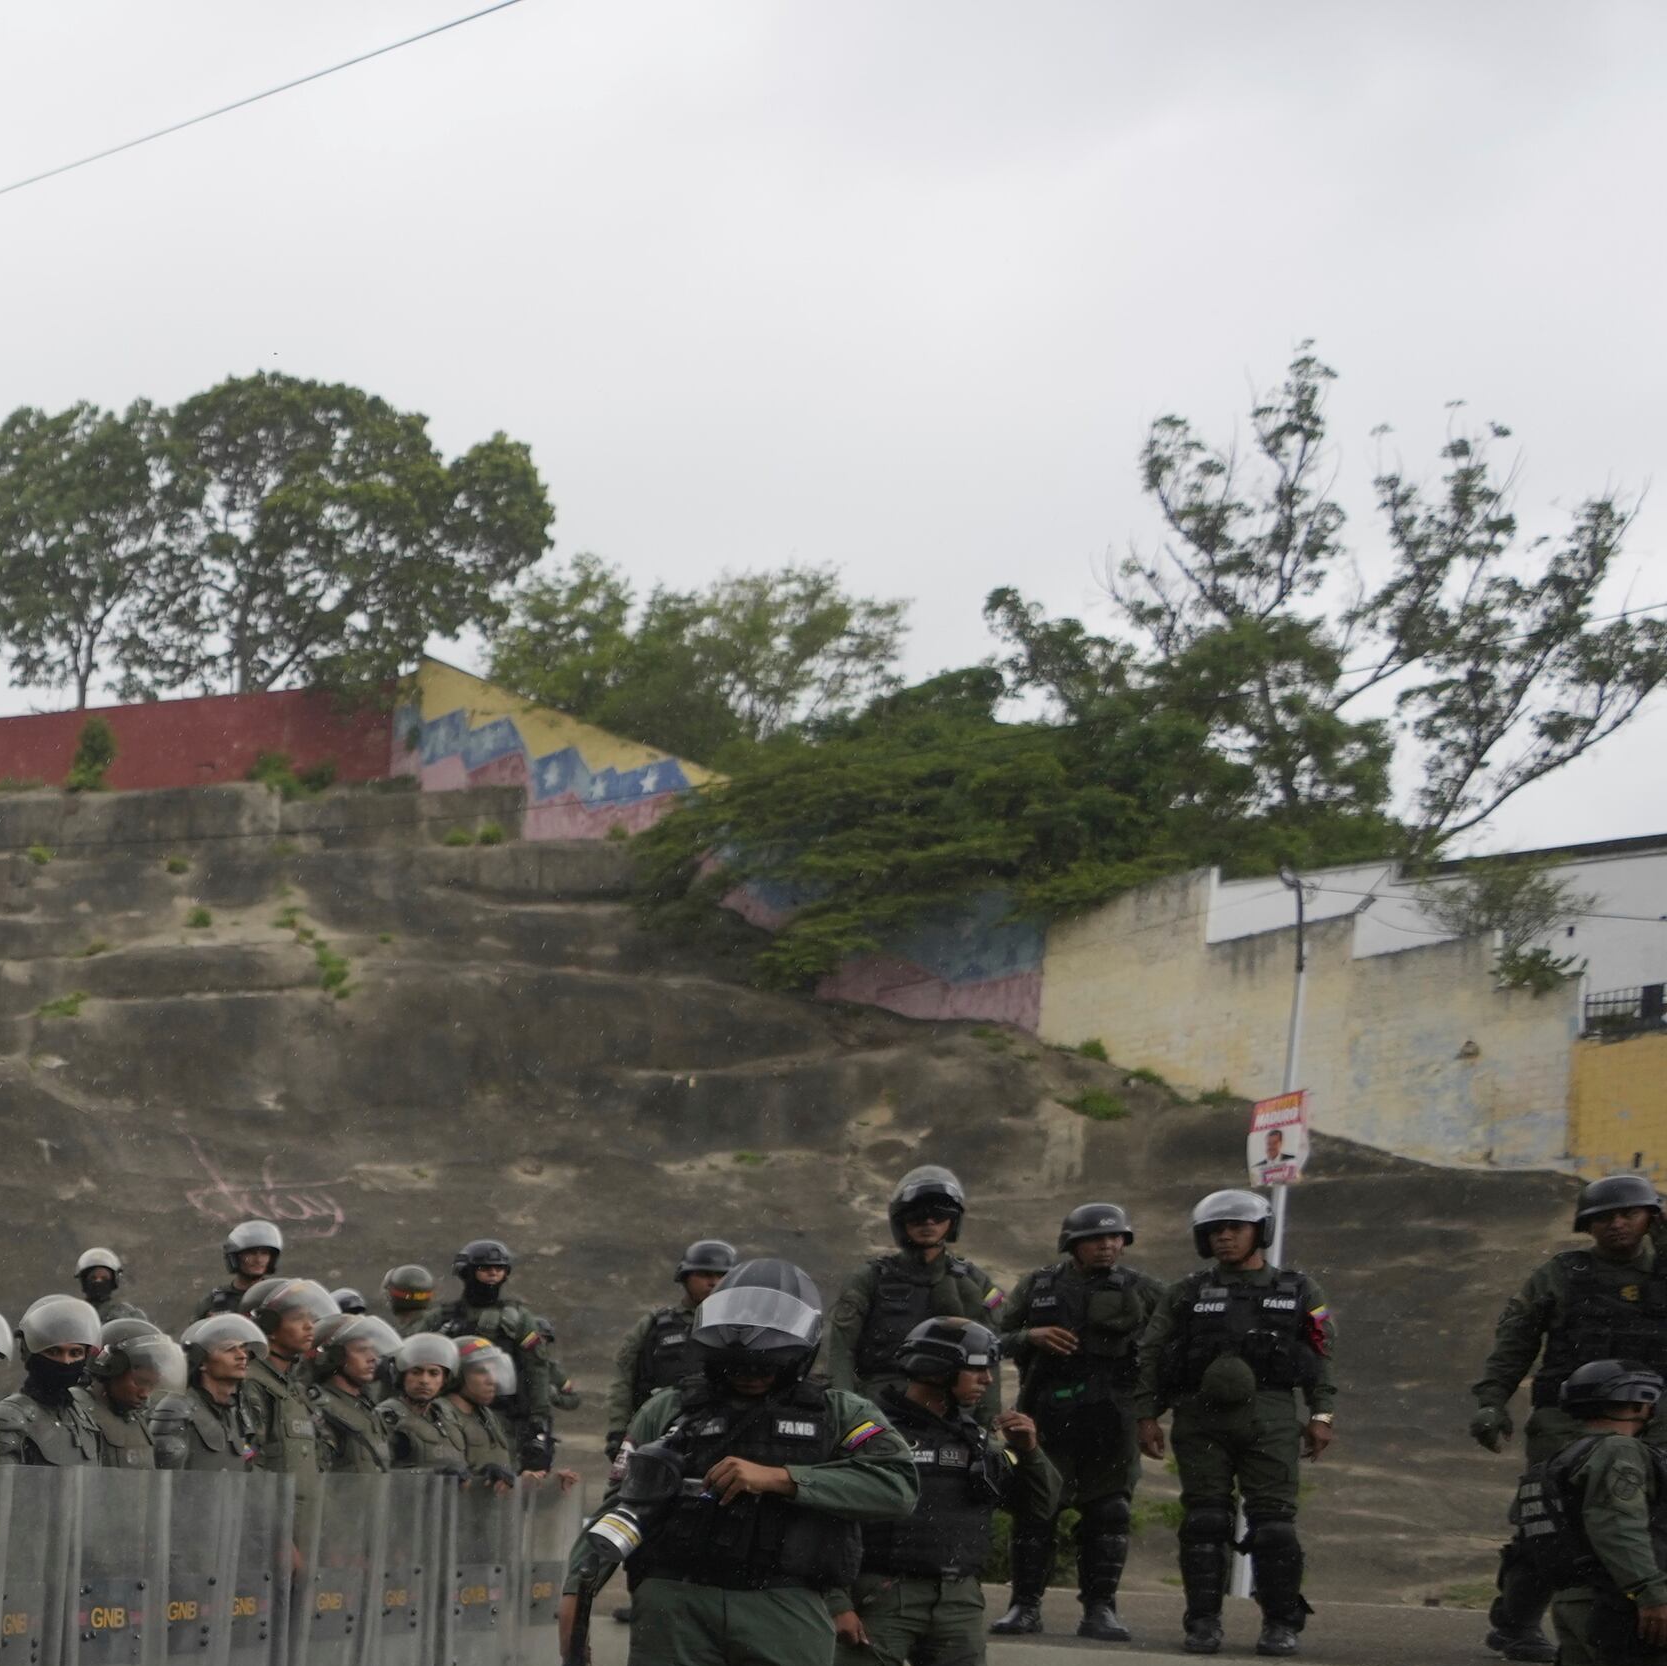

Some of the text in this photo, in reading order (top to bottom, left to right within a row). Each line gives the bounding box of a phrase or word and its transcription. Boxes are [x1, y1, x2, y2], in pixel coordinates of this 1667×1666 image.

[1193, 1302, 1226, 1313] GNB
[1262, 1299, 1297, 1310] FANB
[777, 1420, 816, 1437] FANB
[166, 1601, 198, 1621] GNB
[231, 1597, 257, 1616] GNB
[2, 1613, 28, 1635] GNB
[90, 1607, 126, 1630] GNB
